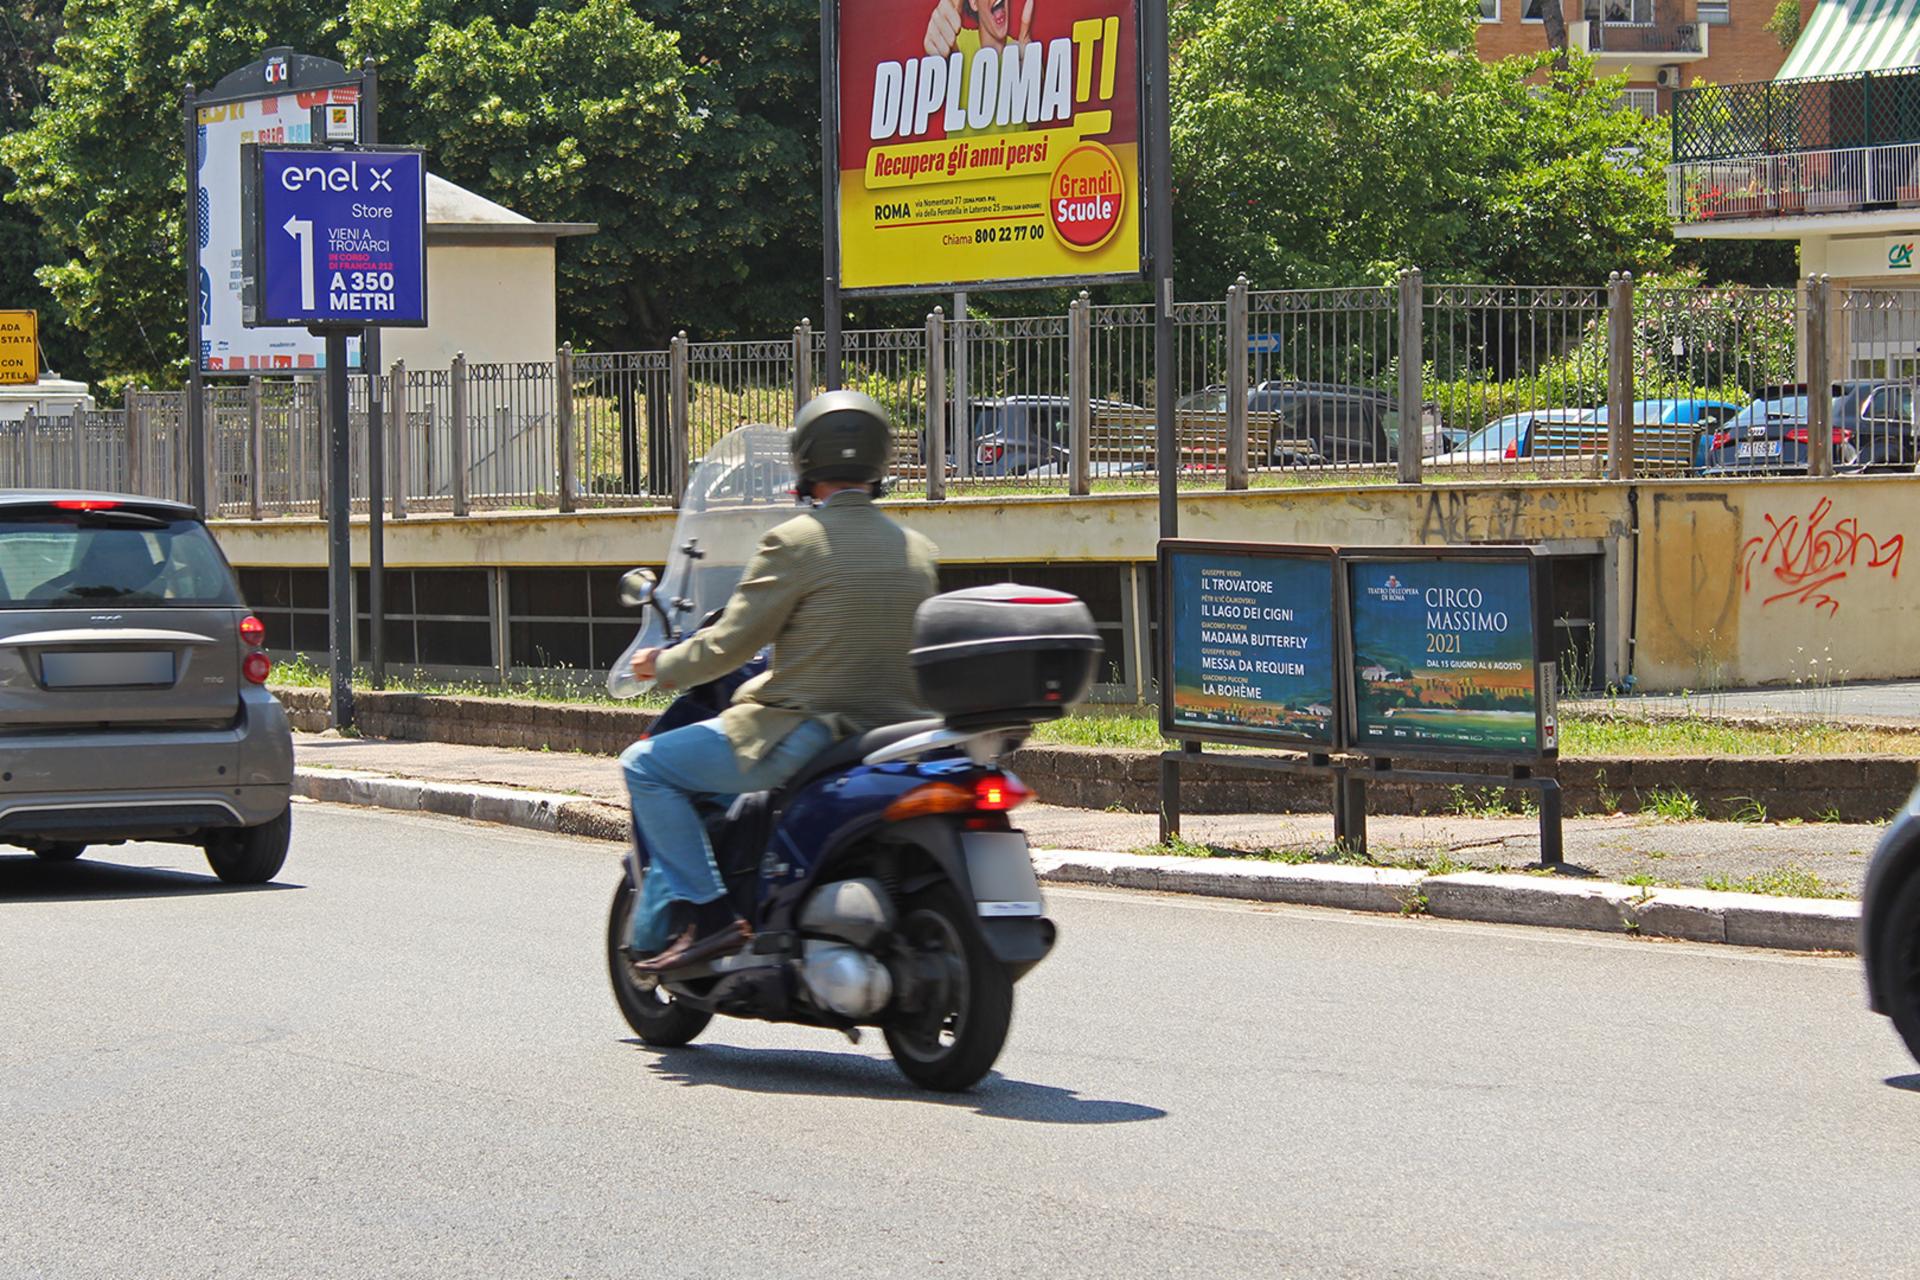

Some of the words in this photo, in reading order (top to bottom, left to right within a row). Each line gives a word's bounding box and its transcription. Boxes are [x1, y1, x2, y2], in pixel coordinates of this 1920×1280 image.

[870, 16, 1120, 140] DIPLOMATI
[874, 153, 945, 179] Recupera
[947, 143, 968, 175] gli
[970, 139, 1005, 168] anni
[1006, 135, 1048, 170] persi
[282, 161, 359, 191] enel
[1060, 169, 1112, 197] Grandi
[954, 196, 962, 204] 77
[993, 203, 1000, 212] 25
[1057, 194, 1112, 222] Scuole
[352, 203, 393, 218] Store
[874, 203, 911, 221] ROMA
[328, 228, 359, 240] VIENI
[362, 228, 372, 240] A
[942, 234, 972, 246] Chiama
[975, 228, 996, 243] 800
[998, 227, 1011, 242] 22
[1014, 226, 1027, 241] 77
[1030, 224, 1044, 240] 00
[328, 239, 390, 252] TROVARCI
[339, 253, 370, 261] CORSO
[340, 262, 377, 270] FRANCIA
[330, 272, 346, 291] A
[351, 272, 394, 291] 350
[329, 293, 395, 310] METRI
[1202, 578, 1210, 590] IL
[1212, 579, 1273, 593] TROVATORE
[1425, 588, 1482, 608] CIRCO
[1202, 605, 1210, 616] IL
[1212, 605, 1241, 617] LAGO
[1243, 607, 1260, 619] DEI
[1263, 608, 1293, 621] CIGNI
[1426, 611, 1508, 632] MASSIMO
[1202, 631, 1249, 645] MADAMA
[1251, 634, 1308, 649] BUTTERFLY
[1426, 633, 1461, 653] 2021
[1202, 657, 1236, 670] MESSA
[1239, 660, 1253, 672] DA
[1256, 661, 1305, 676] REQUIEM
[1426, 659, 1440, 667] DAL
[1450, 660, 1477, 669] GIUGNO
[1478, 661, 1486, 669] AL
[1494, 662, 1522, 670] AGOSTO
[1202, 683, 1216, 695] LA
[1218, 683, 1262, 699] BOHÈME
